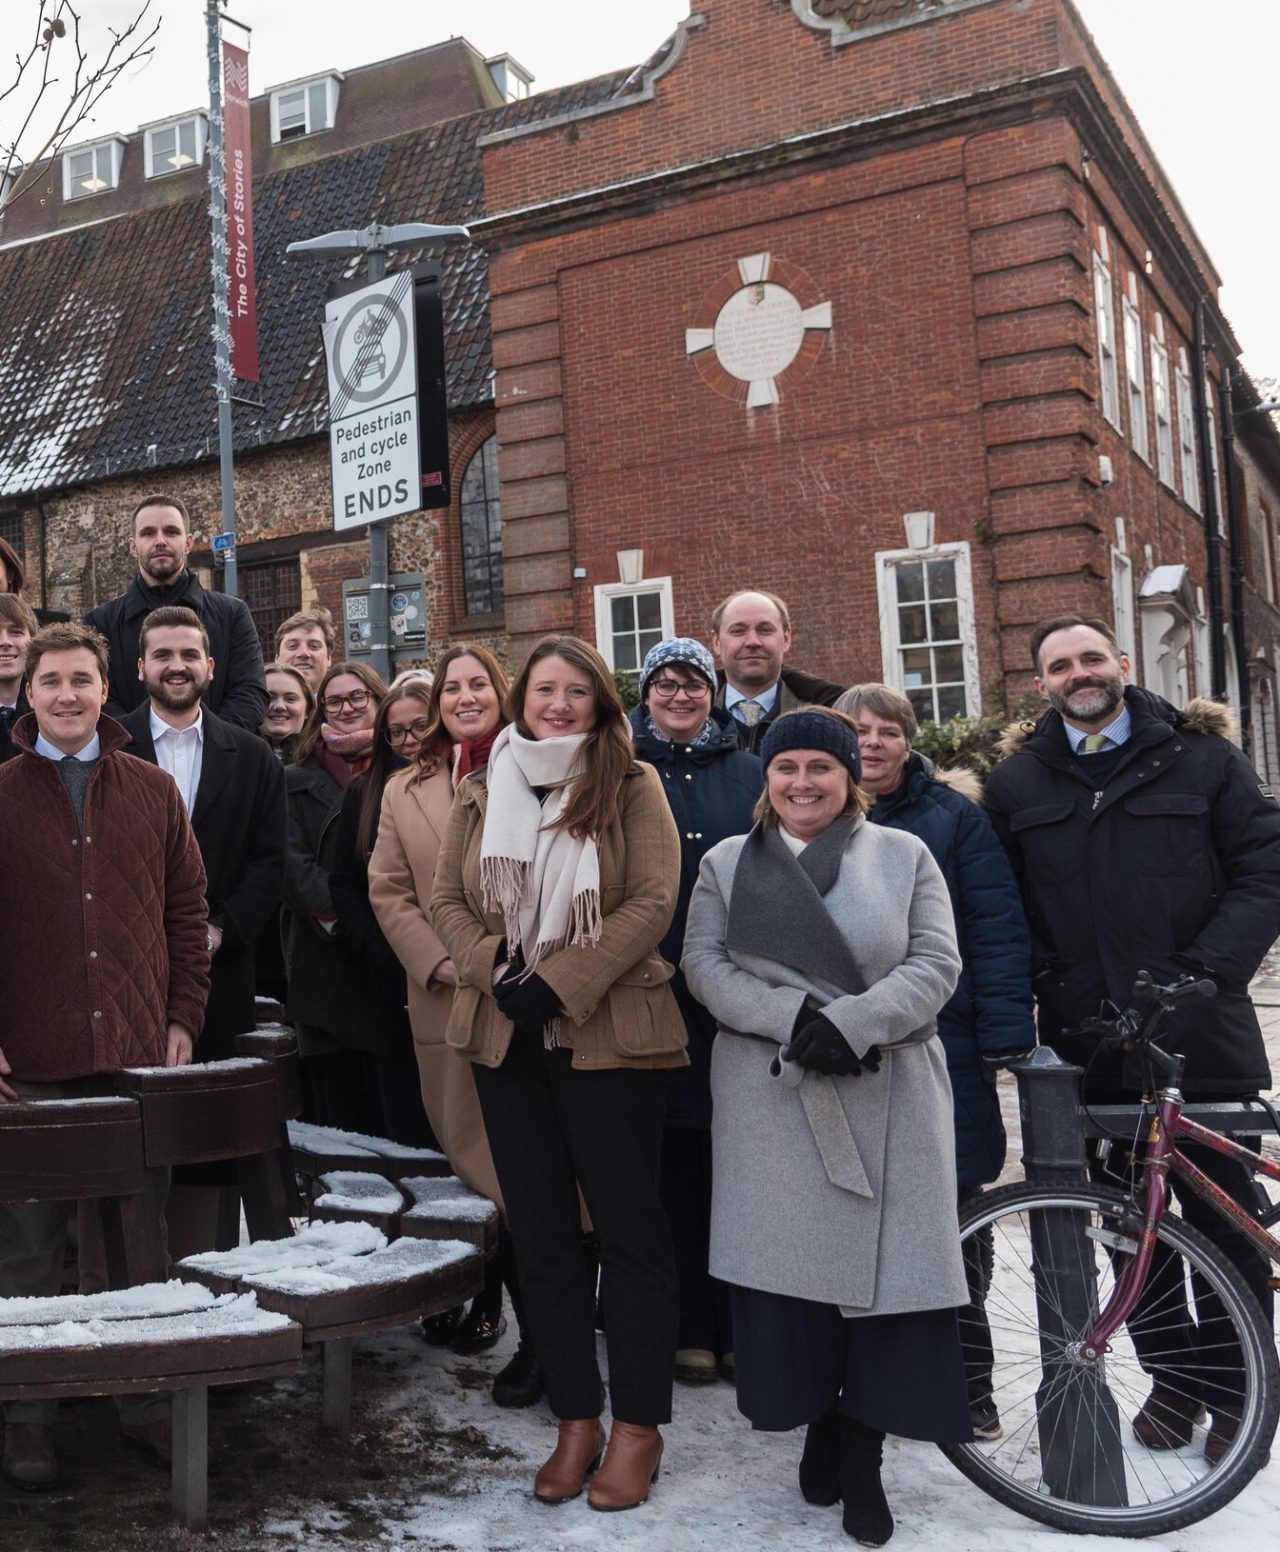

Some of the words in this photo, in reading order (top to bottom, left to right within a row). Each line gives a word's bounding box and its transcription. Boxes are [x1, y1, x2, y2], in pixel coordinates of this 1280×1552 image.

[233, 148, 245, 212] Stories
[233, 214, 245, 236] of
[235, 240, 248, 279] City
[237, 284, 248, 317] The
[336, 409, 412, 445] Pedestrian
[341, 442, 365, 464] and
[370, 431, 408, 456] cycle
[357, 459, 391, 480] Zone
[344, 478, 408, 518] ENDS
